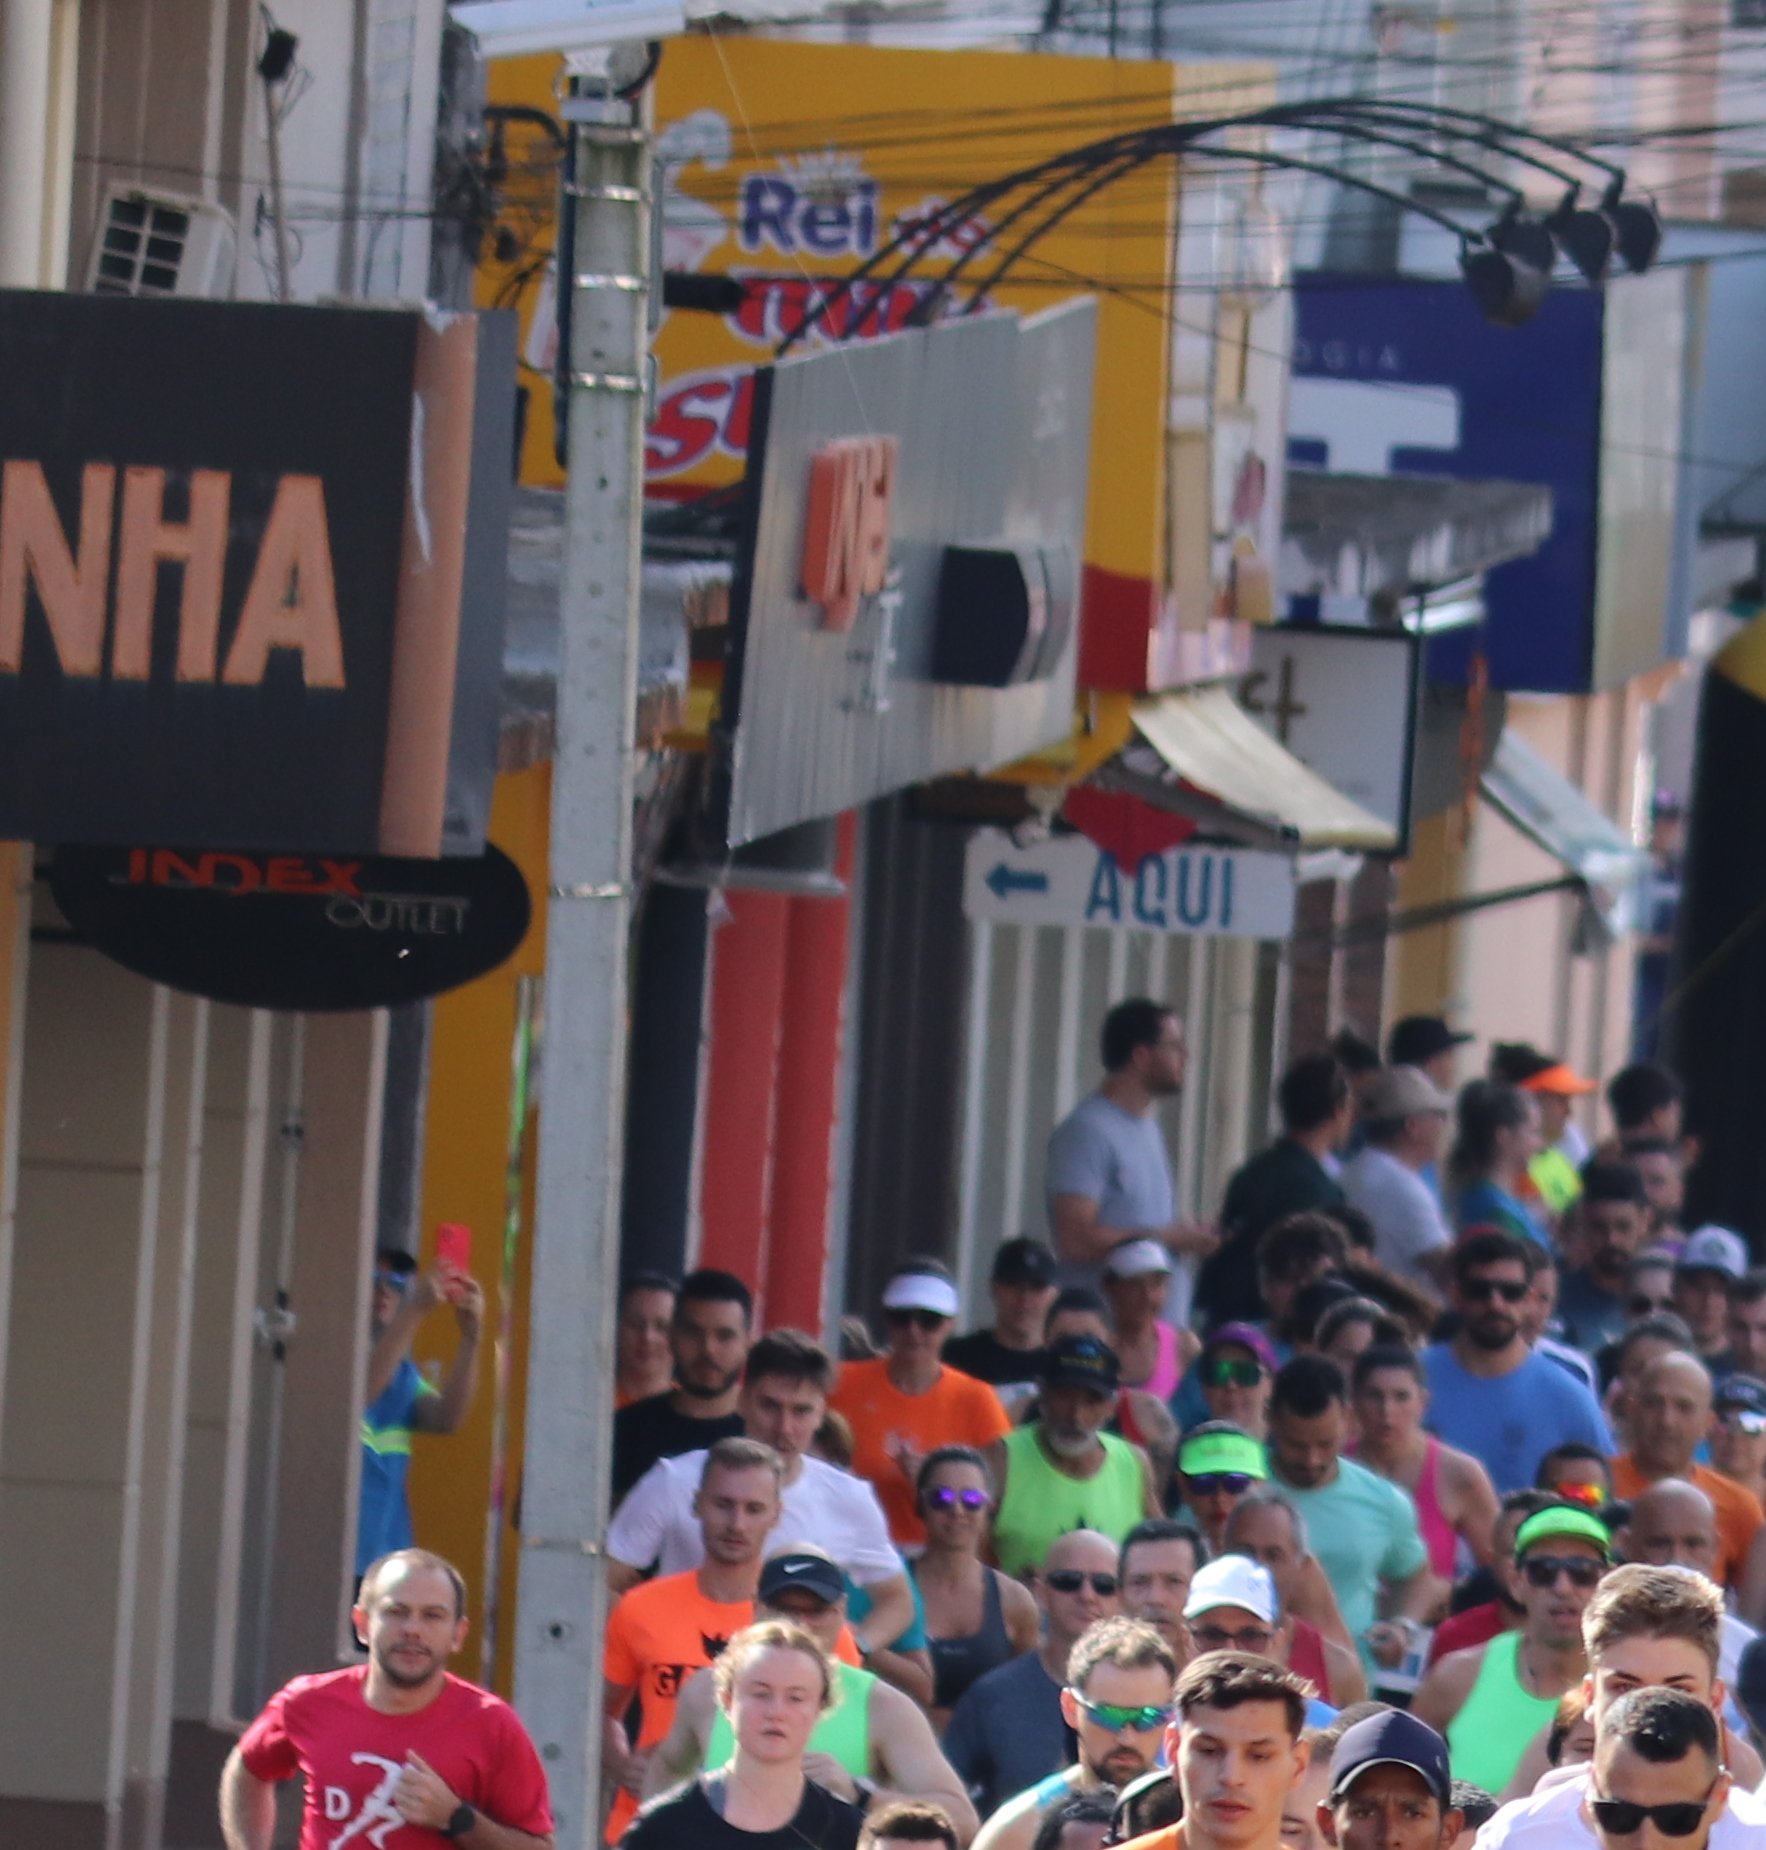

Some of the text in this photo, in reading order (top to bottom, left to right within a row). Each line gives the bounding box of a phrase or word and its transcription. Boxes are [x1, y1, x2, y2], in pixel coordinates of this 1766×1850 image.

[741, 174, 878, 253] Rei
[0, 460, 346, 690] NHA
[128, 848, 363, 898] INDEX
[1084, 852, 1234, 928] AQUI
[325, 895, 469, 934] OUTLET
